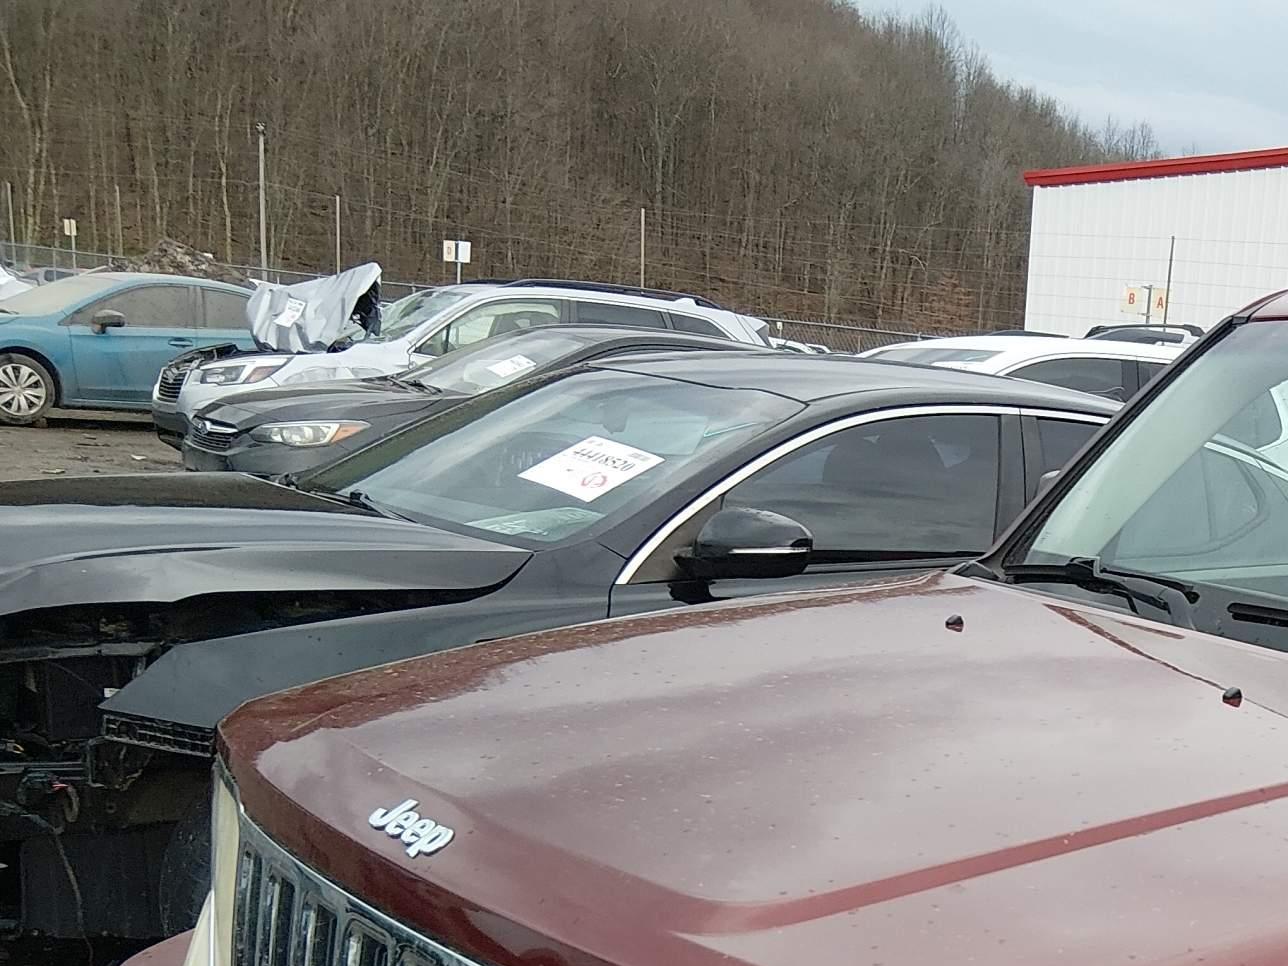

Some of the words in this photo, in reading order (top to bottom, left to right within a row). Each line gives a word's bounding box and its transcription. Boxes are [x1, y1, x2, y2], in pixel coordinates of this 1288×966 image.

[1128, 293, 1135, 304] B
[1156, 297, 1164, 309] A
[368, 798, 455, 859] Jeep
